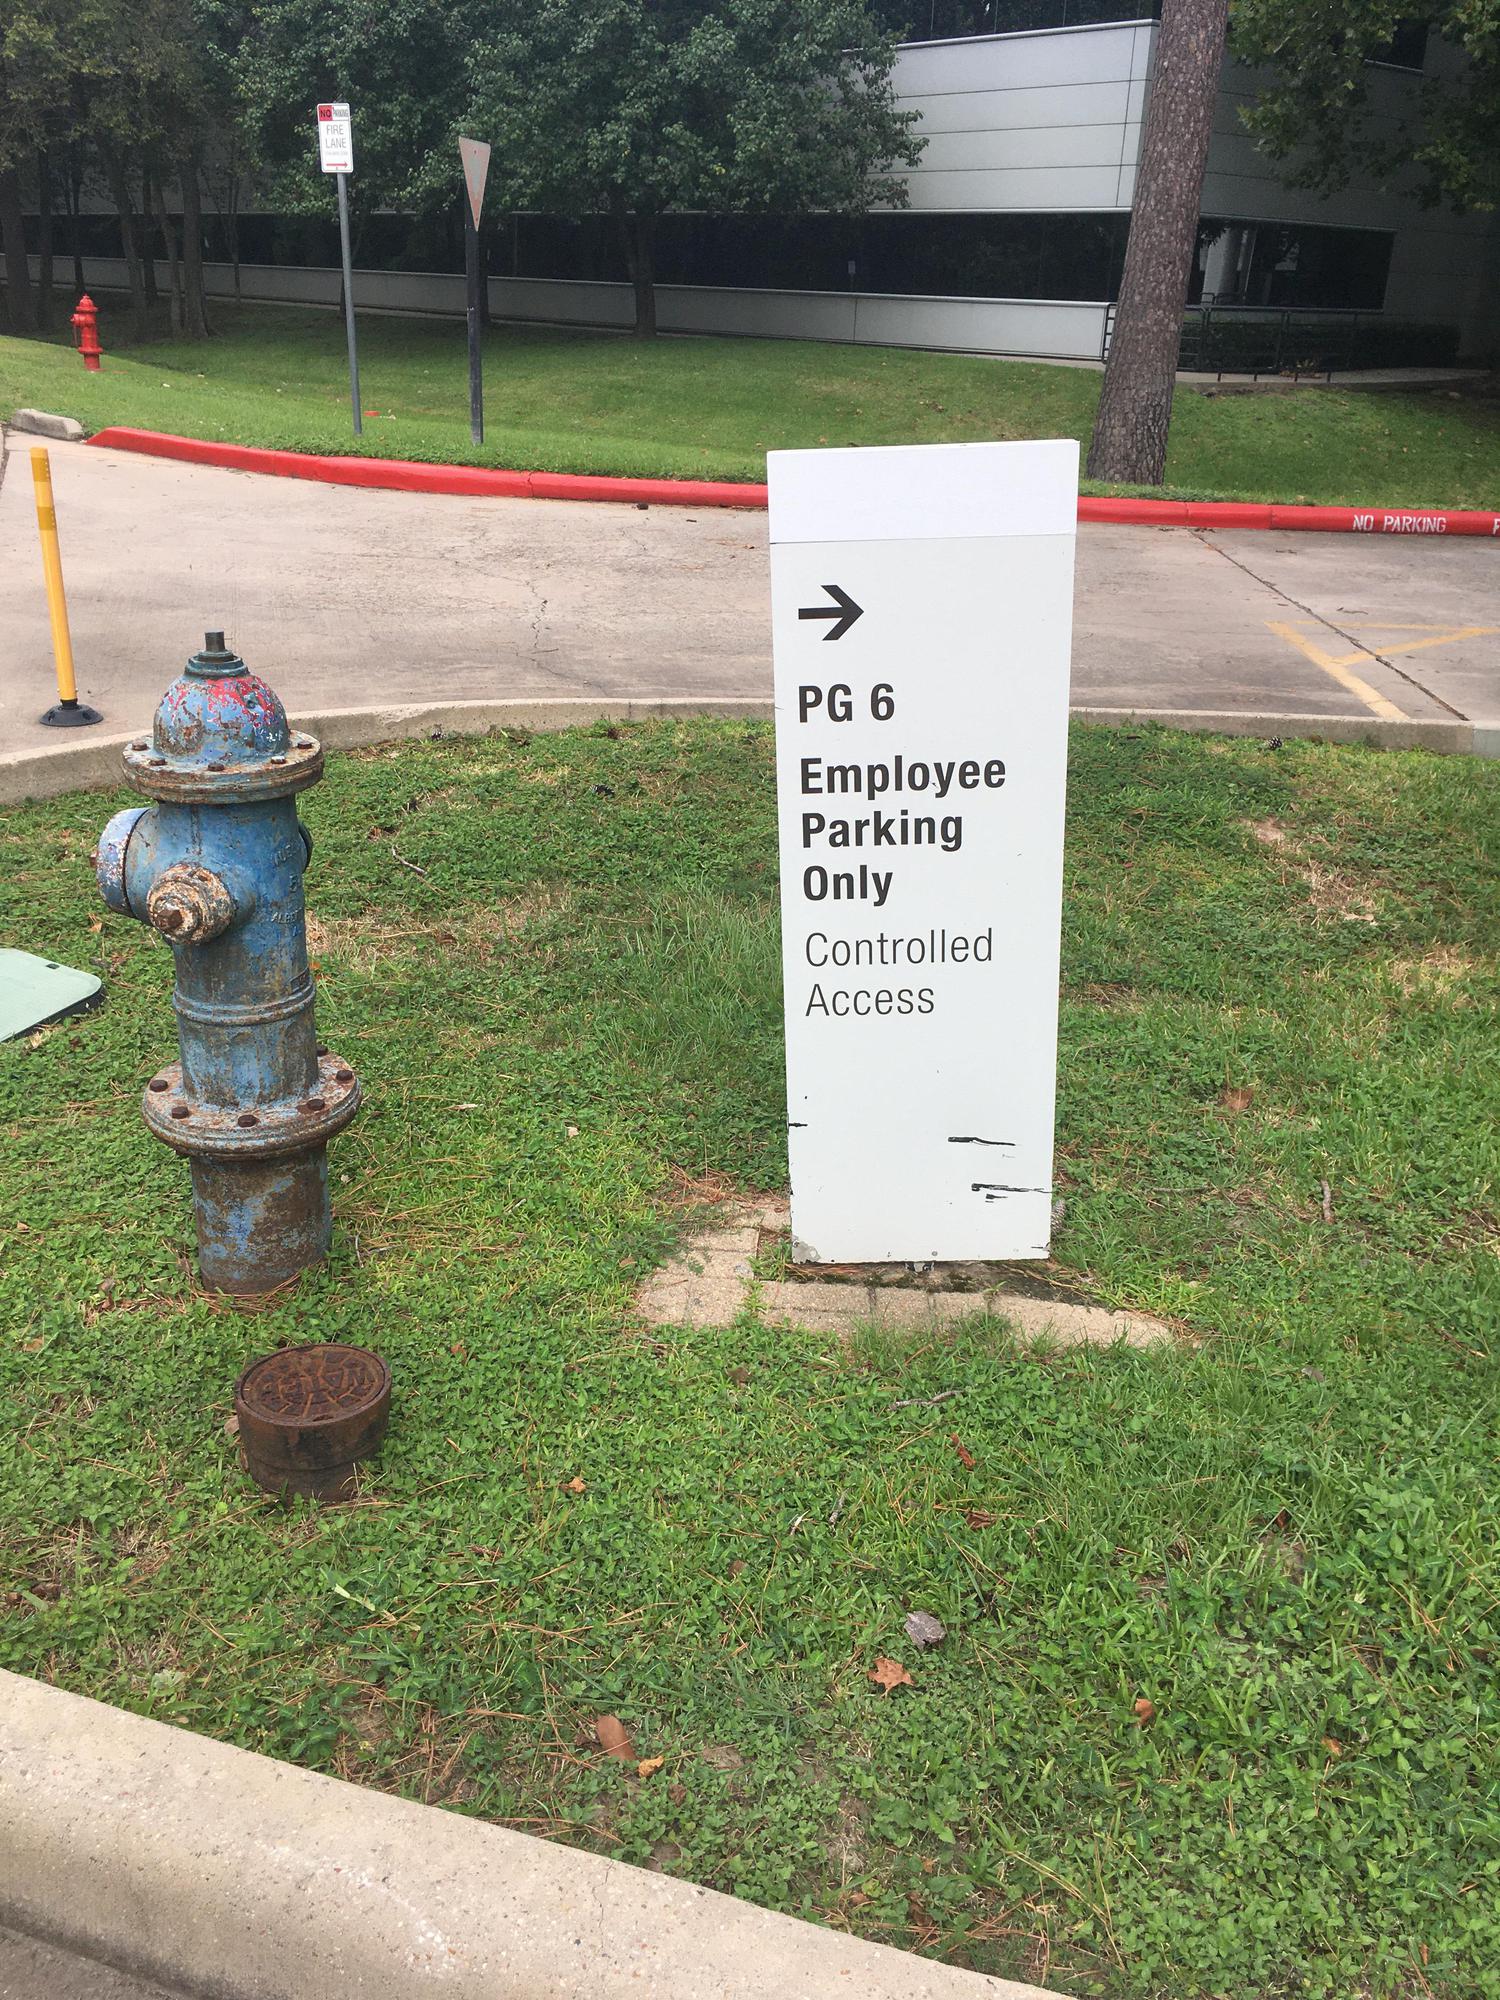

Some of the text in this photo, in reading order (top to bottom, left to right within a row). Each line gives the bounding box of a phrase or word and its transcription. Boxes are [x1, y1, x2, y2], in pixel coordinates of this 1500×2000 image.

[320, 110, 332, 118] NO
[326, 124, 344, 135] FIRE
[325, 138, 347, 149] LANE
[1352, 514, 1447, 533] NO PARKING
[798, 683, 895, 723] PG 6
[800, 755, 1006, 800] Employee
[802, 809, 963, 852] Parking
[803, 864, 893, 906] Only
[805, 928, 992, 967] Controlled
[805, 984, 935, 1017] Access
